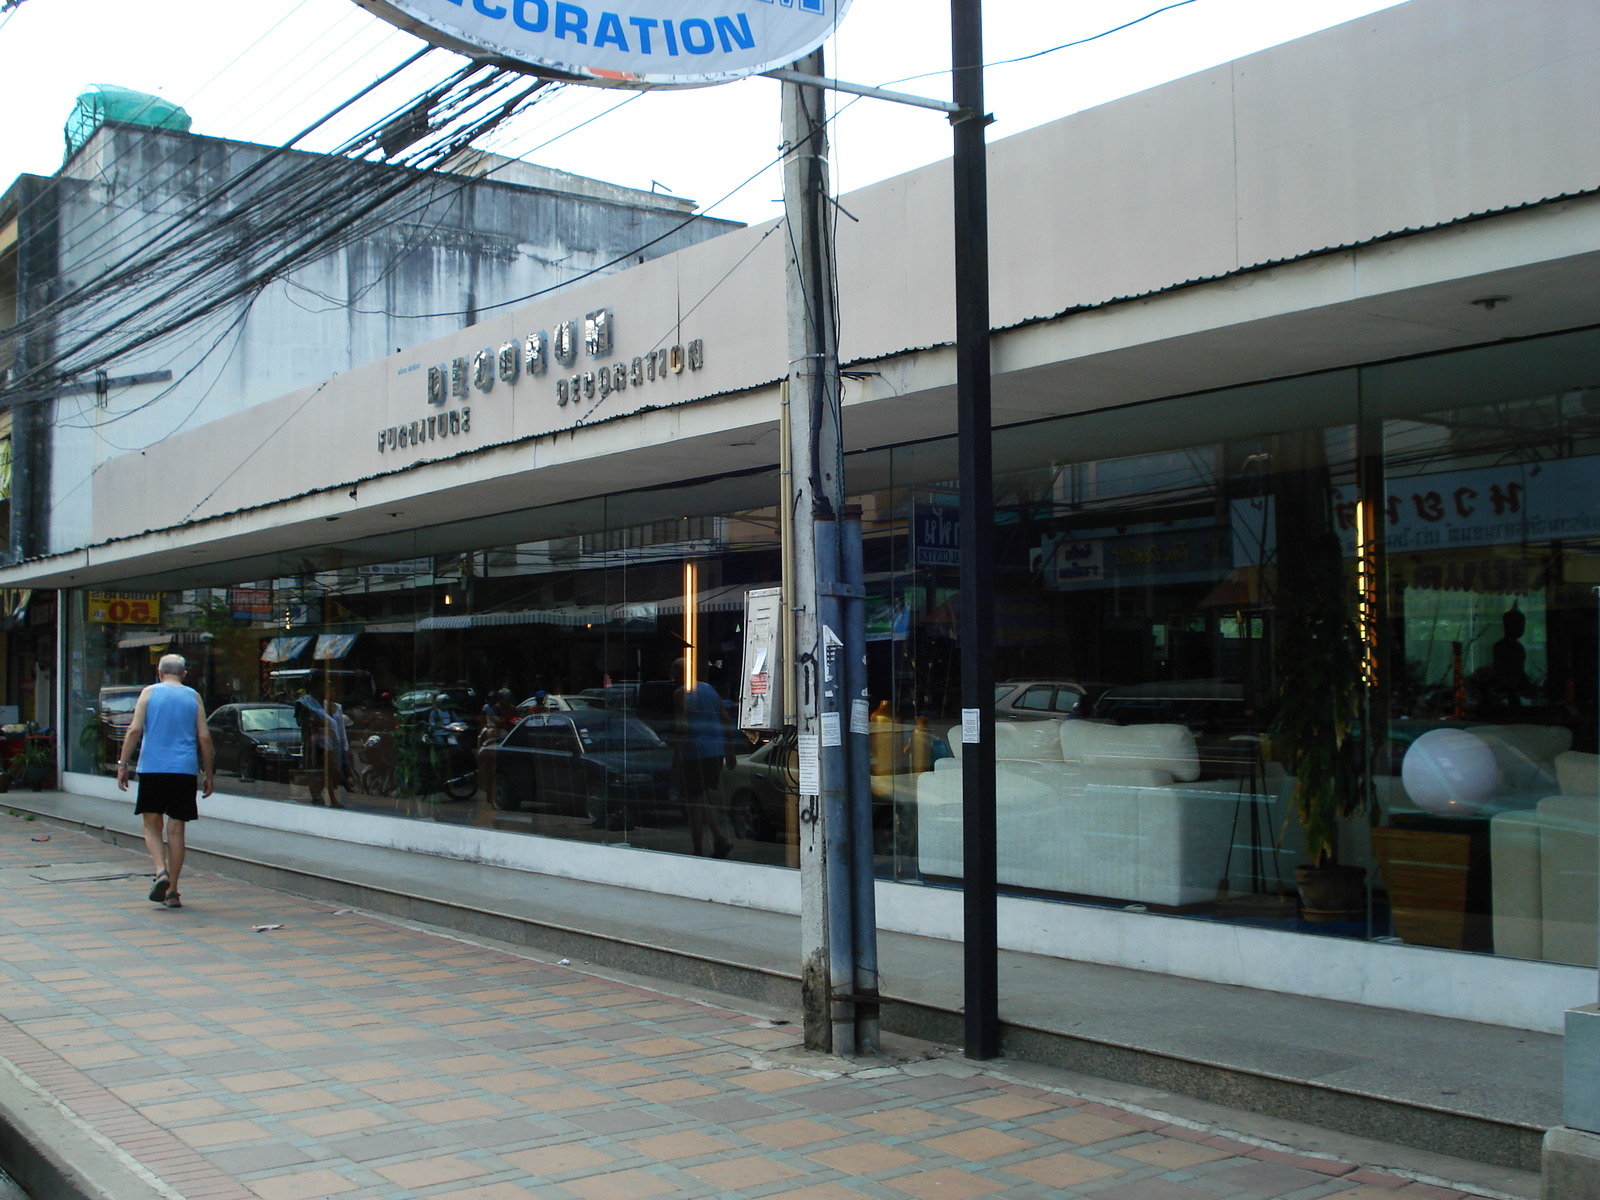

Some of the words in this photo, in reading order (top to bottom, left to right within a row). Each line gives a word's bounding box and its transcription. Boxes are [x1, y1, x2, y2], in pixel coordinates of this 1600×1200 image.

[445, 0, 756, 56] CORATION
[427, 308, 614, 407] DECORUM
[556, 338, 704, 407] DECORATION
[377, 406, 471, 454] FURNITURE
